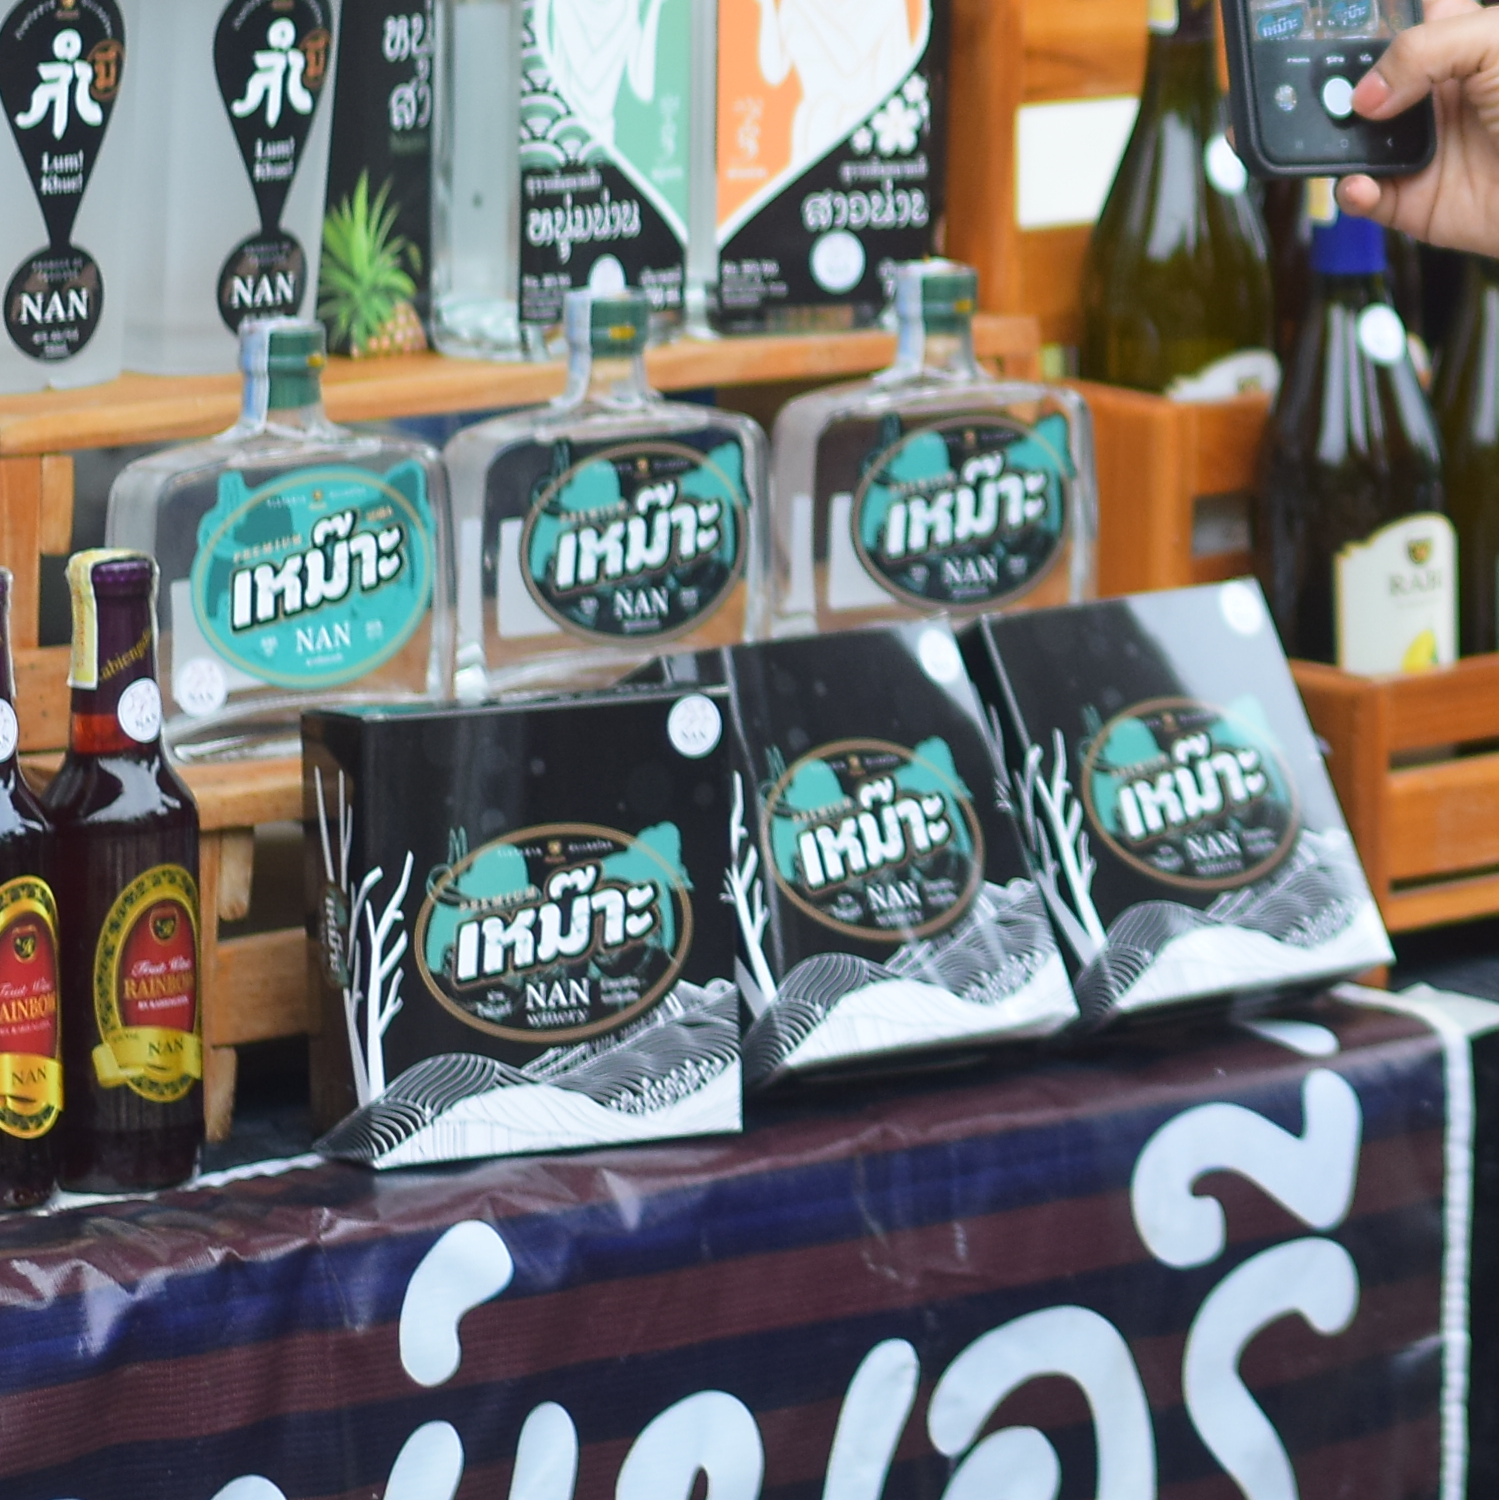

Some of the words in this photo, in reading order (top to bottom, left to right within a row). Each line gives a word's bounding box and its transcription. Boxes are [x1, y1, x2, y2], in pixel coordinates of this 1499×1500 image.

[231, 270, 294, 308] NAN
[18, 289, 89, 325] NAN
[555, 479, 720, 591] เหม๊าะ
[232, 509, 402, 631] เหม๊าะ
[943, 554, 998, 586] NAN
[613, 586, 669, 619] NAN
[295, 622, 351, 653] NAN
[1187, 829, 1242, 862] NAN
[867, 878, 922, 912] NAN
[456, 863, 655, 982] เหม๊าะ
[524, 977, 591, 1010] NAN
[148, 1037, 184, 1057] NAN
[12, 1065, 47, 1087] NAN
